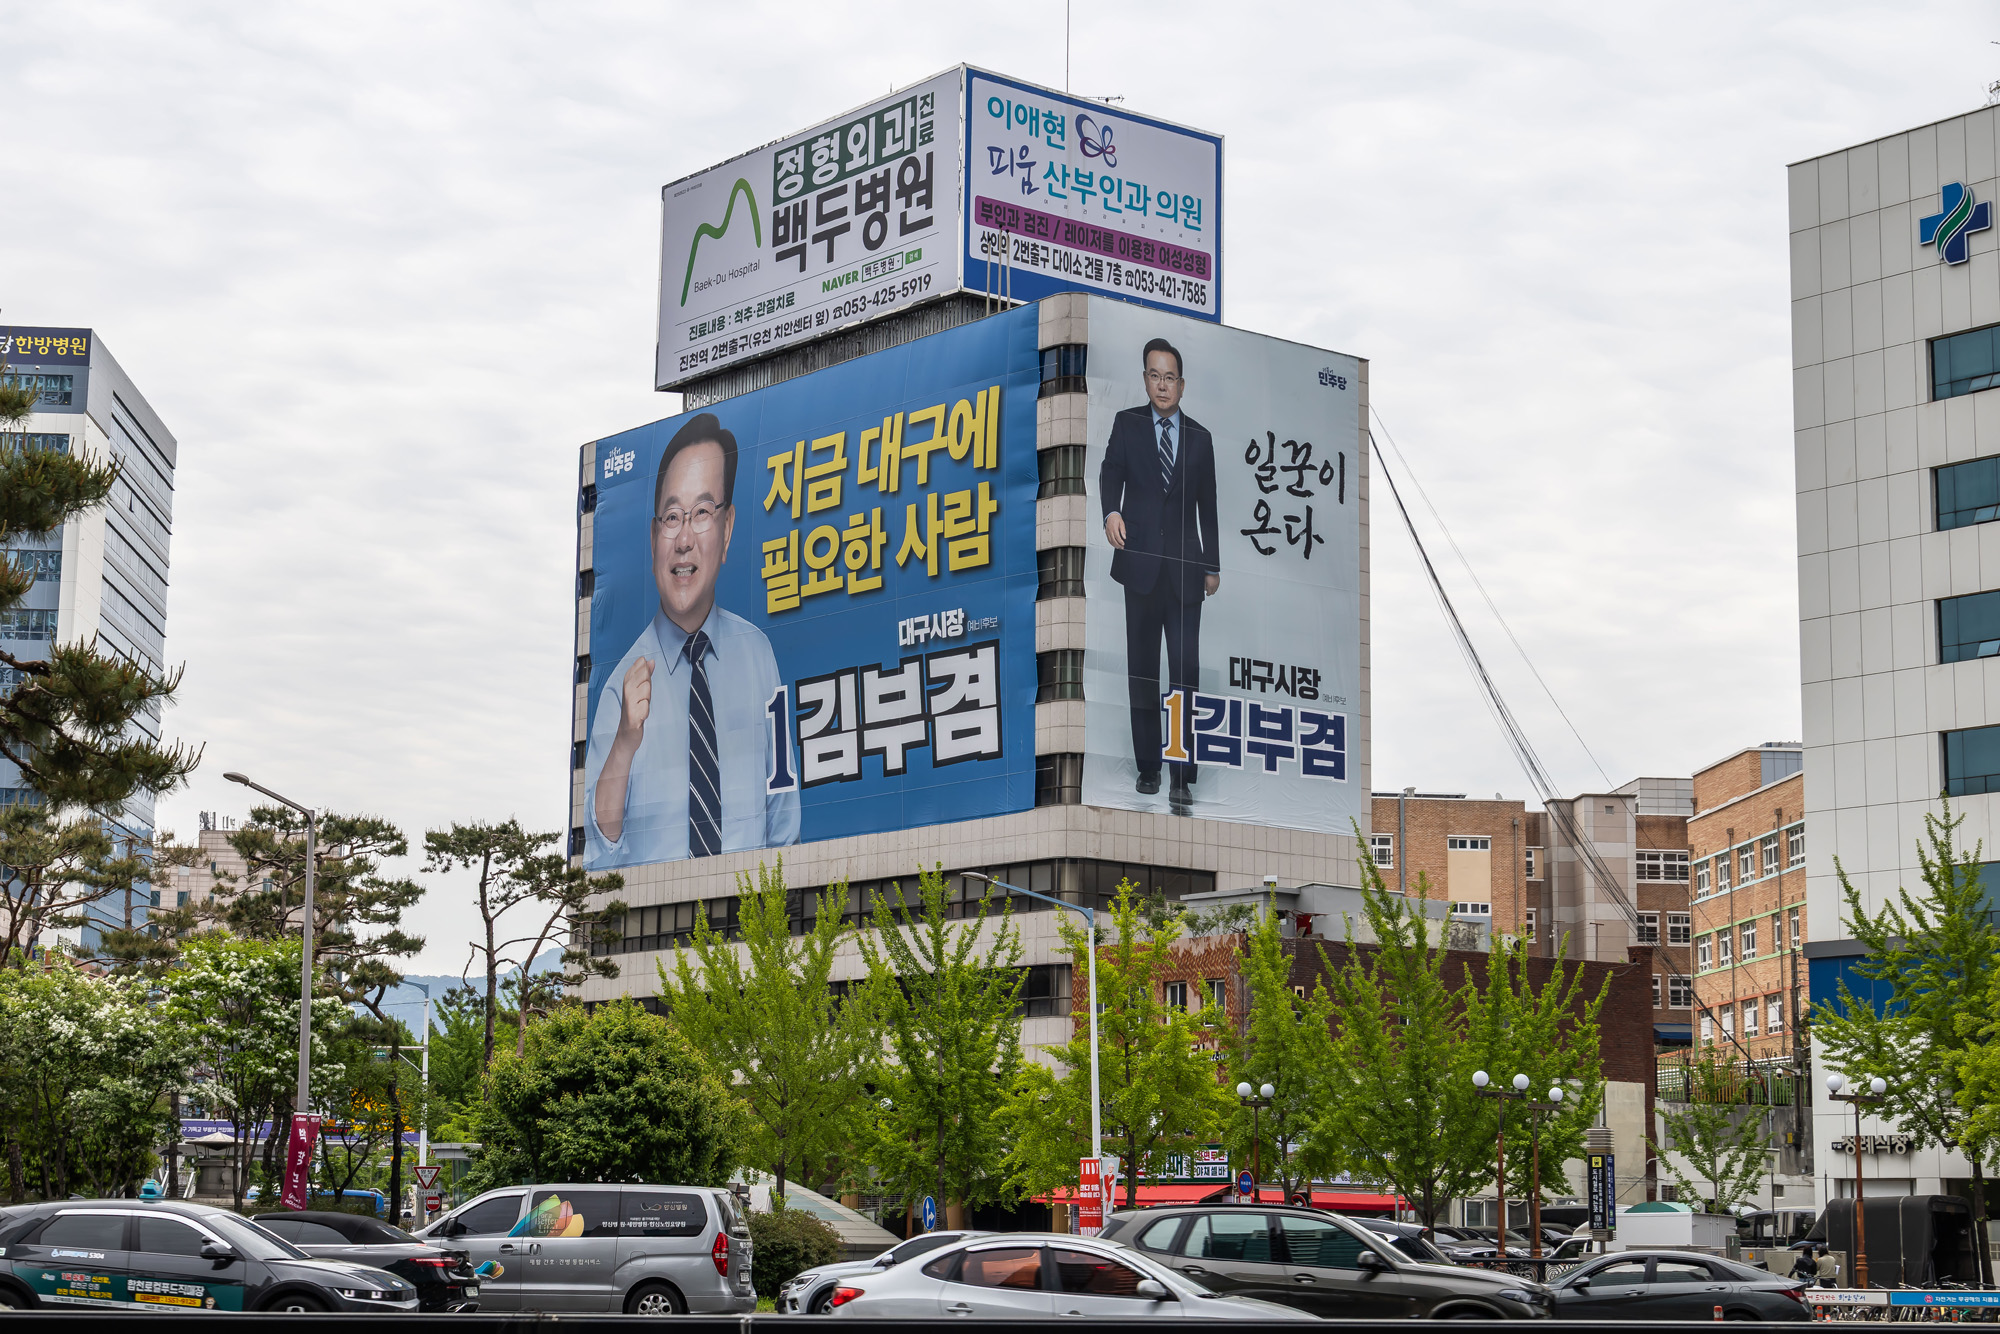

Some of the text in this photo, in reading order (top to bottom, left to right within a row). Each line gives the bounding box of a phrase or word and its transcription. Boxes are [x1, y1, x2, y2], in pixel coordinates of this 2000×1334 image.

[919, 91, 935, 147] 진료
[987, 96, 1066, 150] 이애현
[777, 101, 915, 198] 정형외과
[986, 144, 1040, 196] 피움
[772, 152, 934, 273] 백두병원
[980, 201, 1020, 232] 부인과
[1024, 211, 1049, 238] 검진
[1064, 223, 1115, 254] 레이저를
[1118, 236, 1156, 263] 이용한
[1158, 245, 1207, 276] 여성성형
[694, 259, 761, 293] Baek-Du Hospital
[822, 271, 860, 293] NAVER
[864, 257, 896, 278] 백두병원
[1013, 238, 1050, 270] 2번출구
[1106, 262, 1122, 287] 7층
[679, 345, 709, 373] 진천역
[774, 315, 813, 341] 치안센터
[815, 308, 830, 328] 옆)
[688, 314, 726, 341] 진료내용
[734, 291, 795, 325] 척추·관절치료
[15, 336, 87, 356] 한방병원
[1318, 371, 1347, 391] 민주당
[604, 450, 635, 479] 민주당
[762, 385, 1000, 520] 지금 대구에
[1245, 431, 1345, 505] 일꾼이
[761, 480, 998, 614] 필요한 사람
[1240, 499, 1325, 560] 온다
[898, 608, 998, 647] 대구시장 예비후보
[1229, 656, 1321, 700] 대구시장
